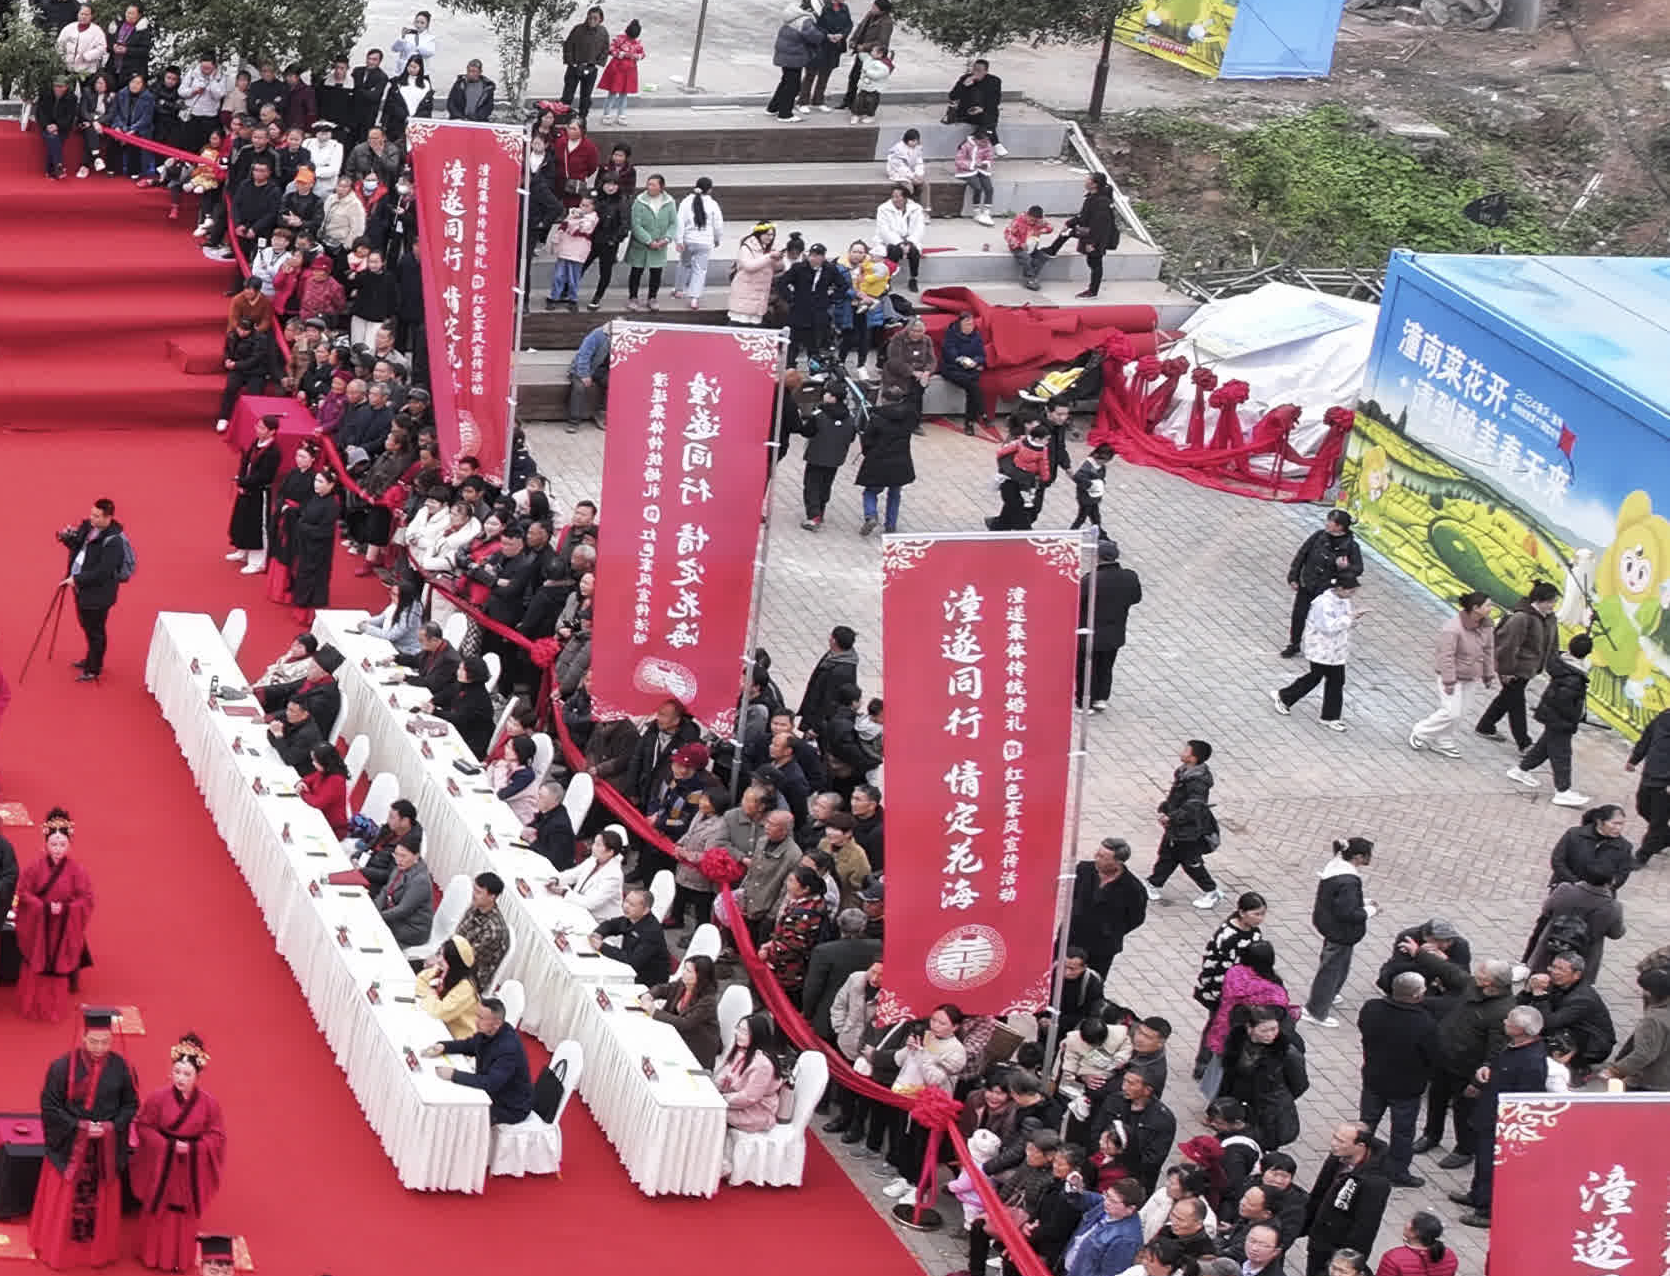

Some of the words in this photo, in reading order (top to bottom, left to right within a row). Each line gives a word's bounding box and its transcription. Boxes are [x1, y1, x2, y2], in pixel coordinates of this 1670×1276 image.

[441, 159, 467, 271] 潼遂同行
[442, 285, 463, 395] 情定花
[940, 584, 985, 740] 潼遂同行
[1004, 586, 1028, 732] 潼遂集体传统婚礼
[940, 760, 984, 910] 情定花海
[999, 766, 1025, 902] 红色家风宣传活动
